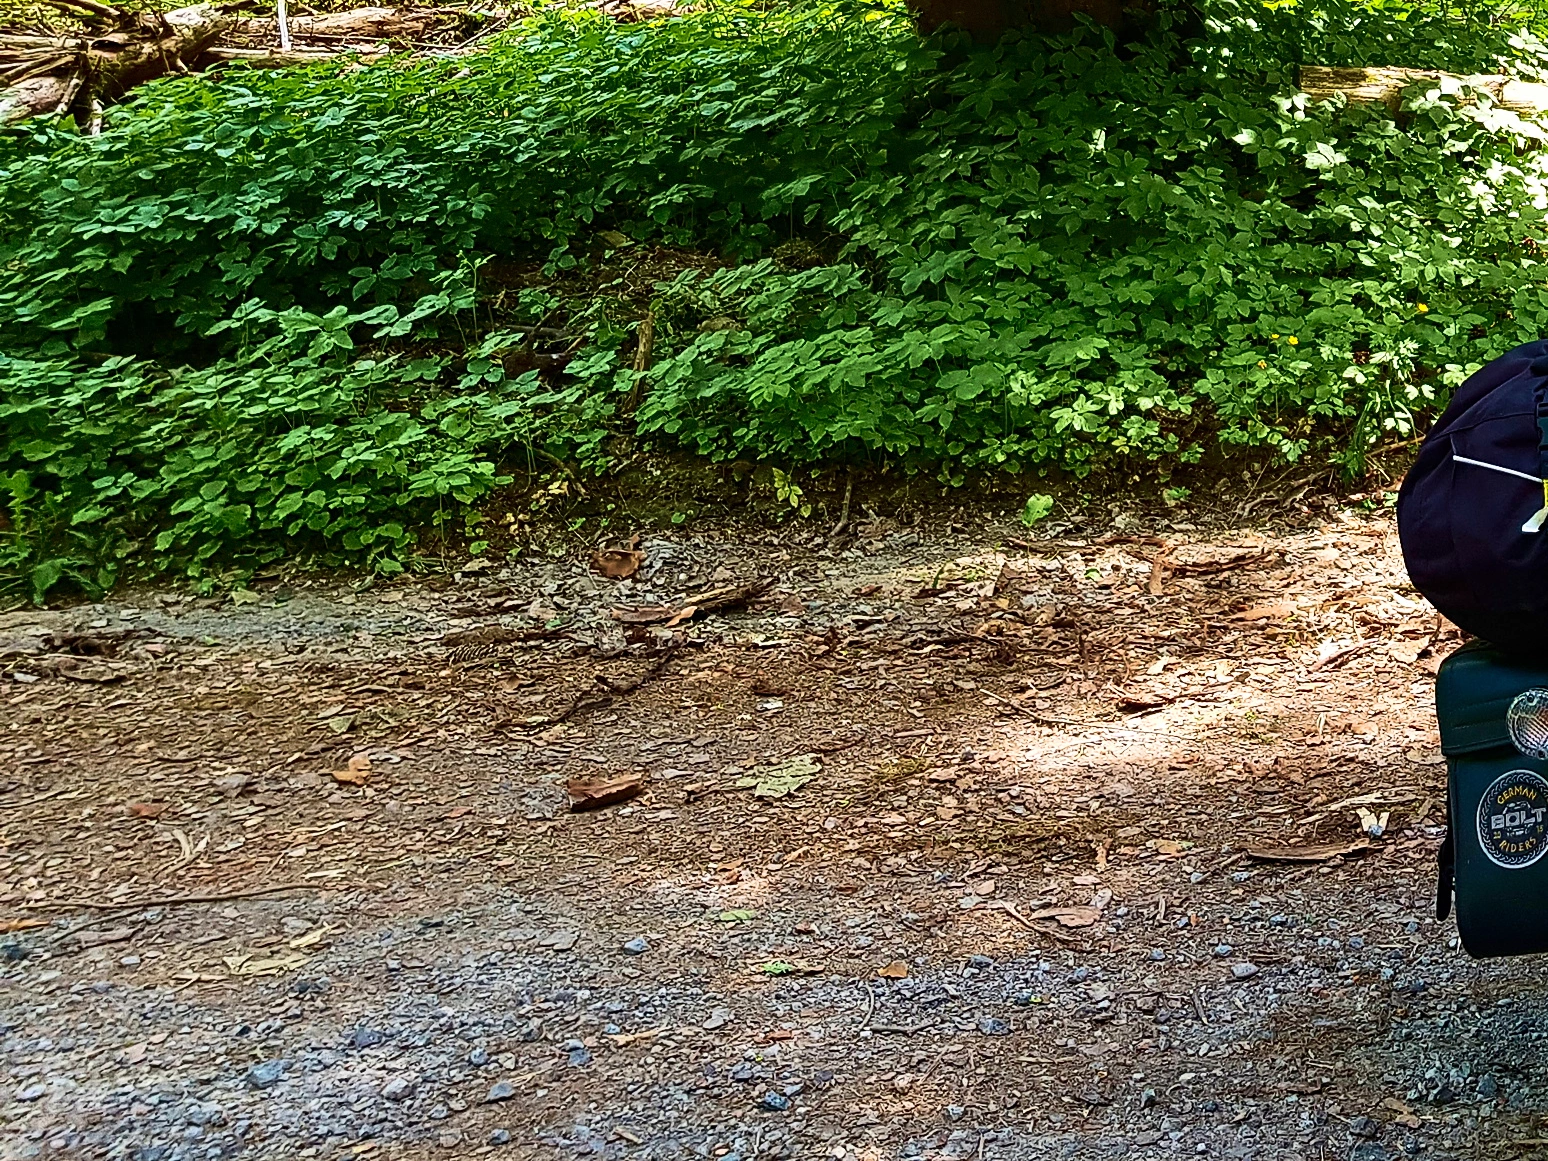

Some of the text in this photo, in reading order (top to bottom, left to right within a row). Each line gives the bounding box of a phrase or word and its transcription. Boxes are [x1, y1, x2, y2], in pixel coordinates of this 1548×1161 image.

[1497, 785, 1537, 805] GERMAN
[1491, 807, 1546, 830] BOLT
[1499, 836, 1537, 853] RIDERS
